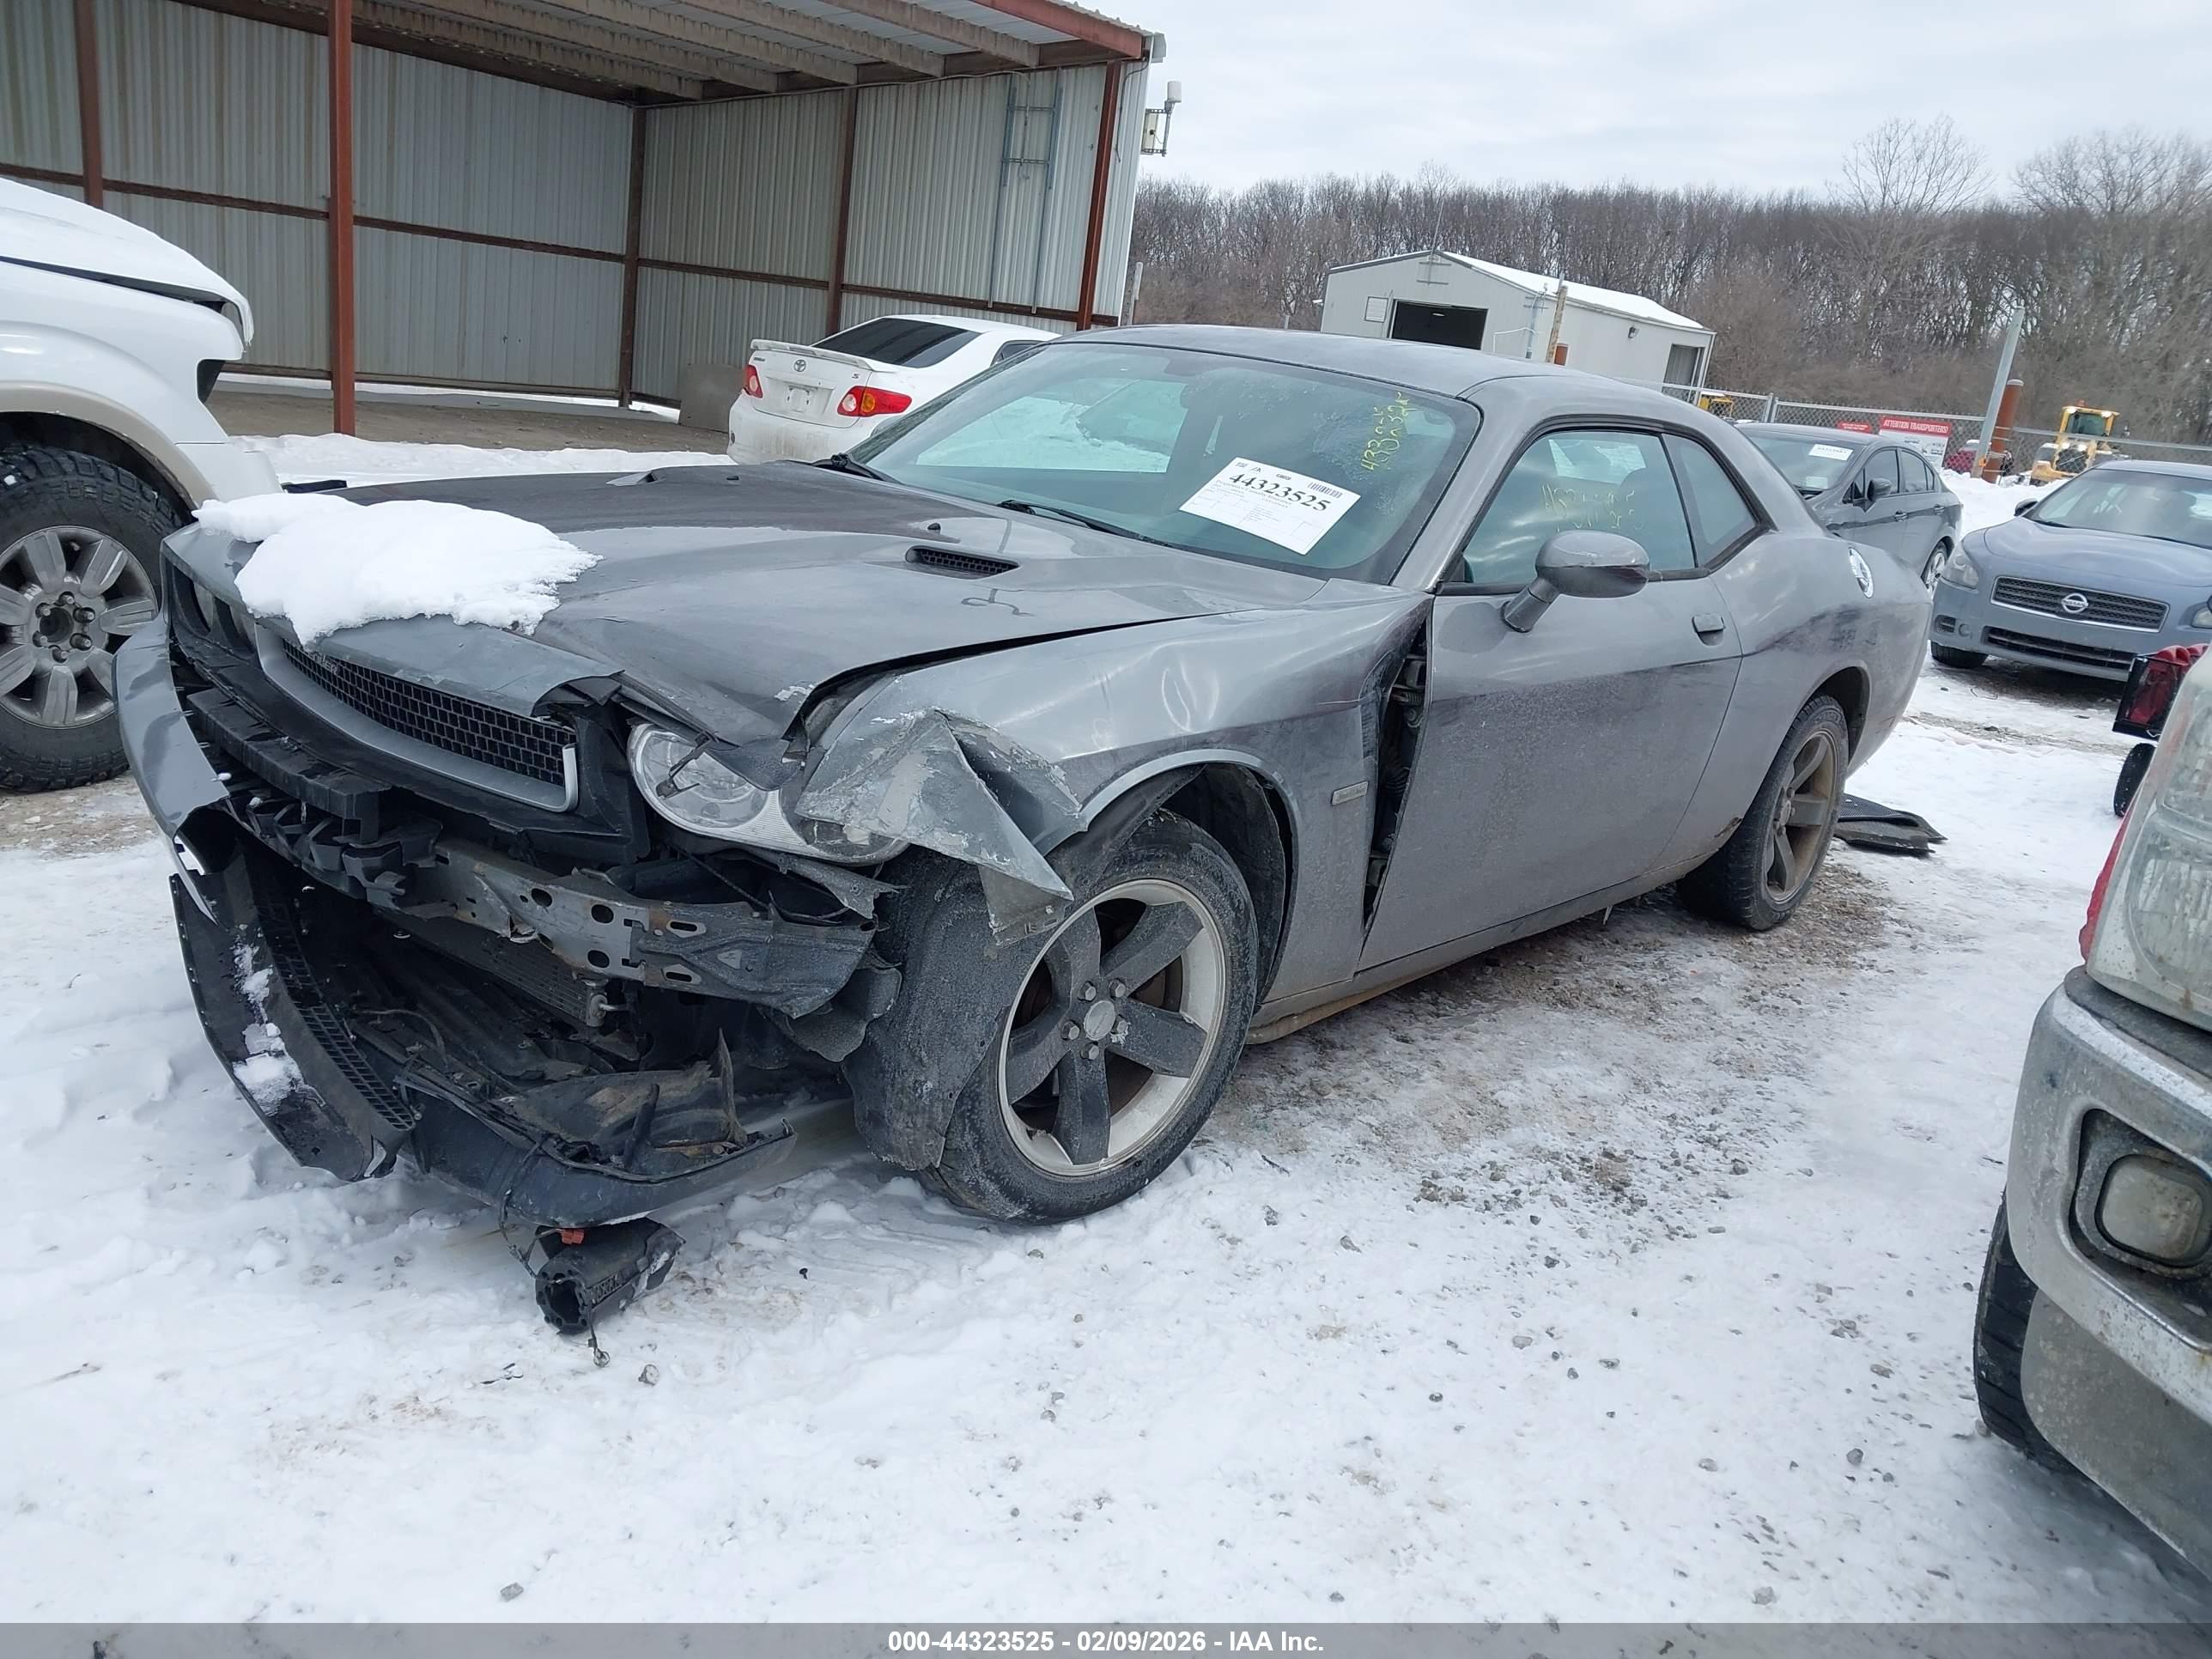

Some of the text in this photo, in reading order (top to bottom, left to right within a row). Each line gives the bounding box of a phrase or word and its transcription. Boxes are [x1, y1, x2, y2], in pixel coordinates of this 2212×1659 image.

[1883, 419, 1949, 434] ATTENTION TRANSPORTERS!
[1230, 473, 1331, 511] 44323525
